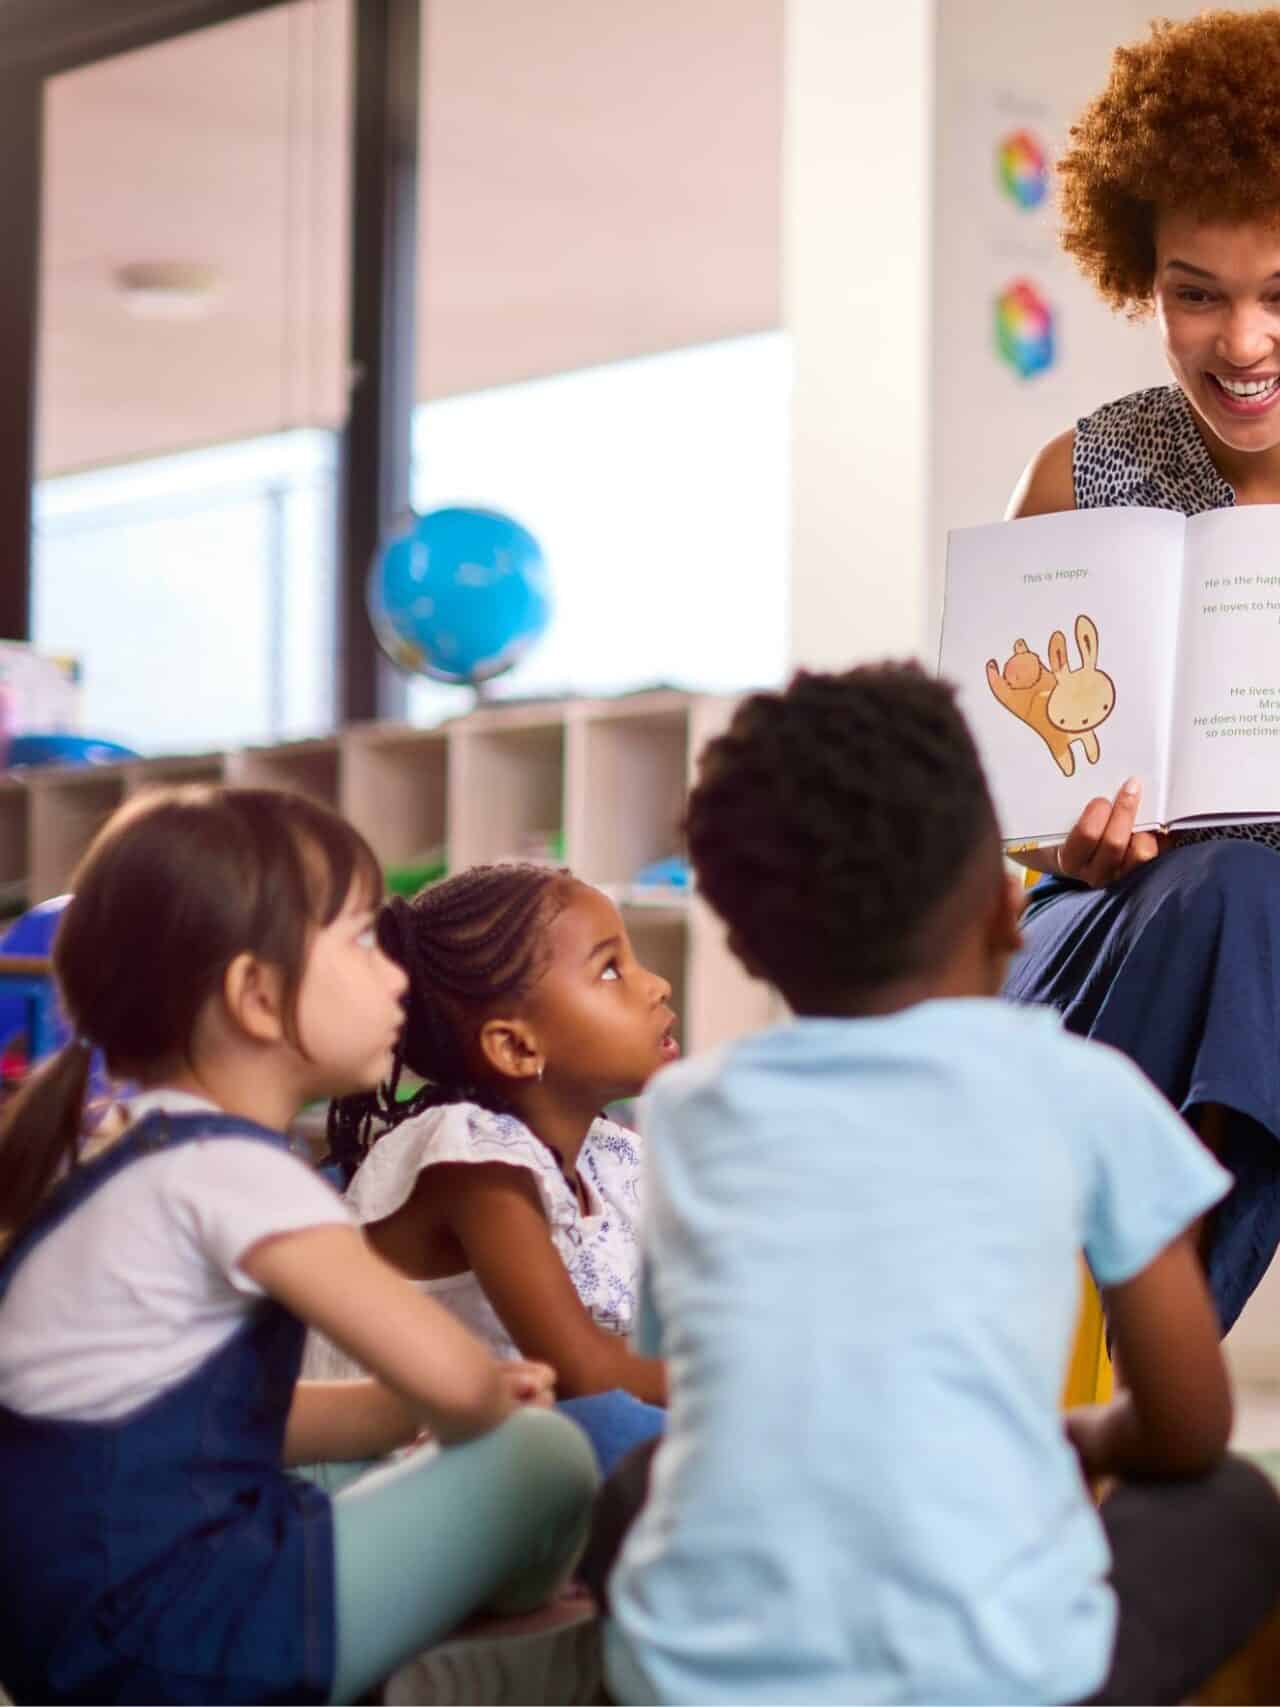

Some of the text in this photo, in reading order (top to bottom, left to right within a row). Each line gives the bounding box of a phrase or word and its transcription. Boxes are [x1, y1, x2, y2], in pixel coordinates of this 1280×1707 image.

[1023, 573, 1042, 585] This
[1204, 577, 1220, 589] He
[1222, 576, 1232, 586] is
[1234, 575, 1254, 585] the
[1203, 604, 1218, 615] He
[1220, 602, 1248, 613] loves
[1251, 600, 1264, 610] to
[1230, 686, 1246, 697] He
[1248, 685, 1275, 697] lives
[1193, 714, 1209, 726] He
[1210, 712, 1236, 724] does
[1239, 713, 1257, 723] not
[1205, 728, 1218, 739] so
